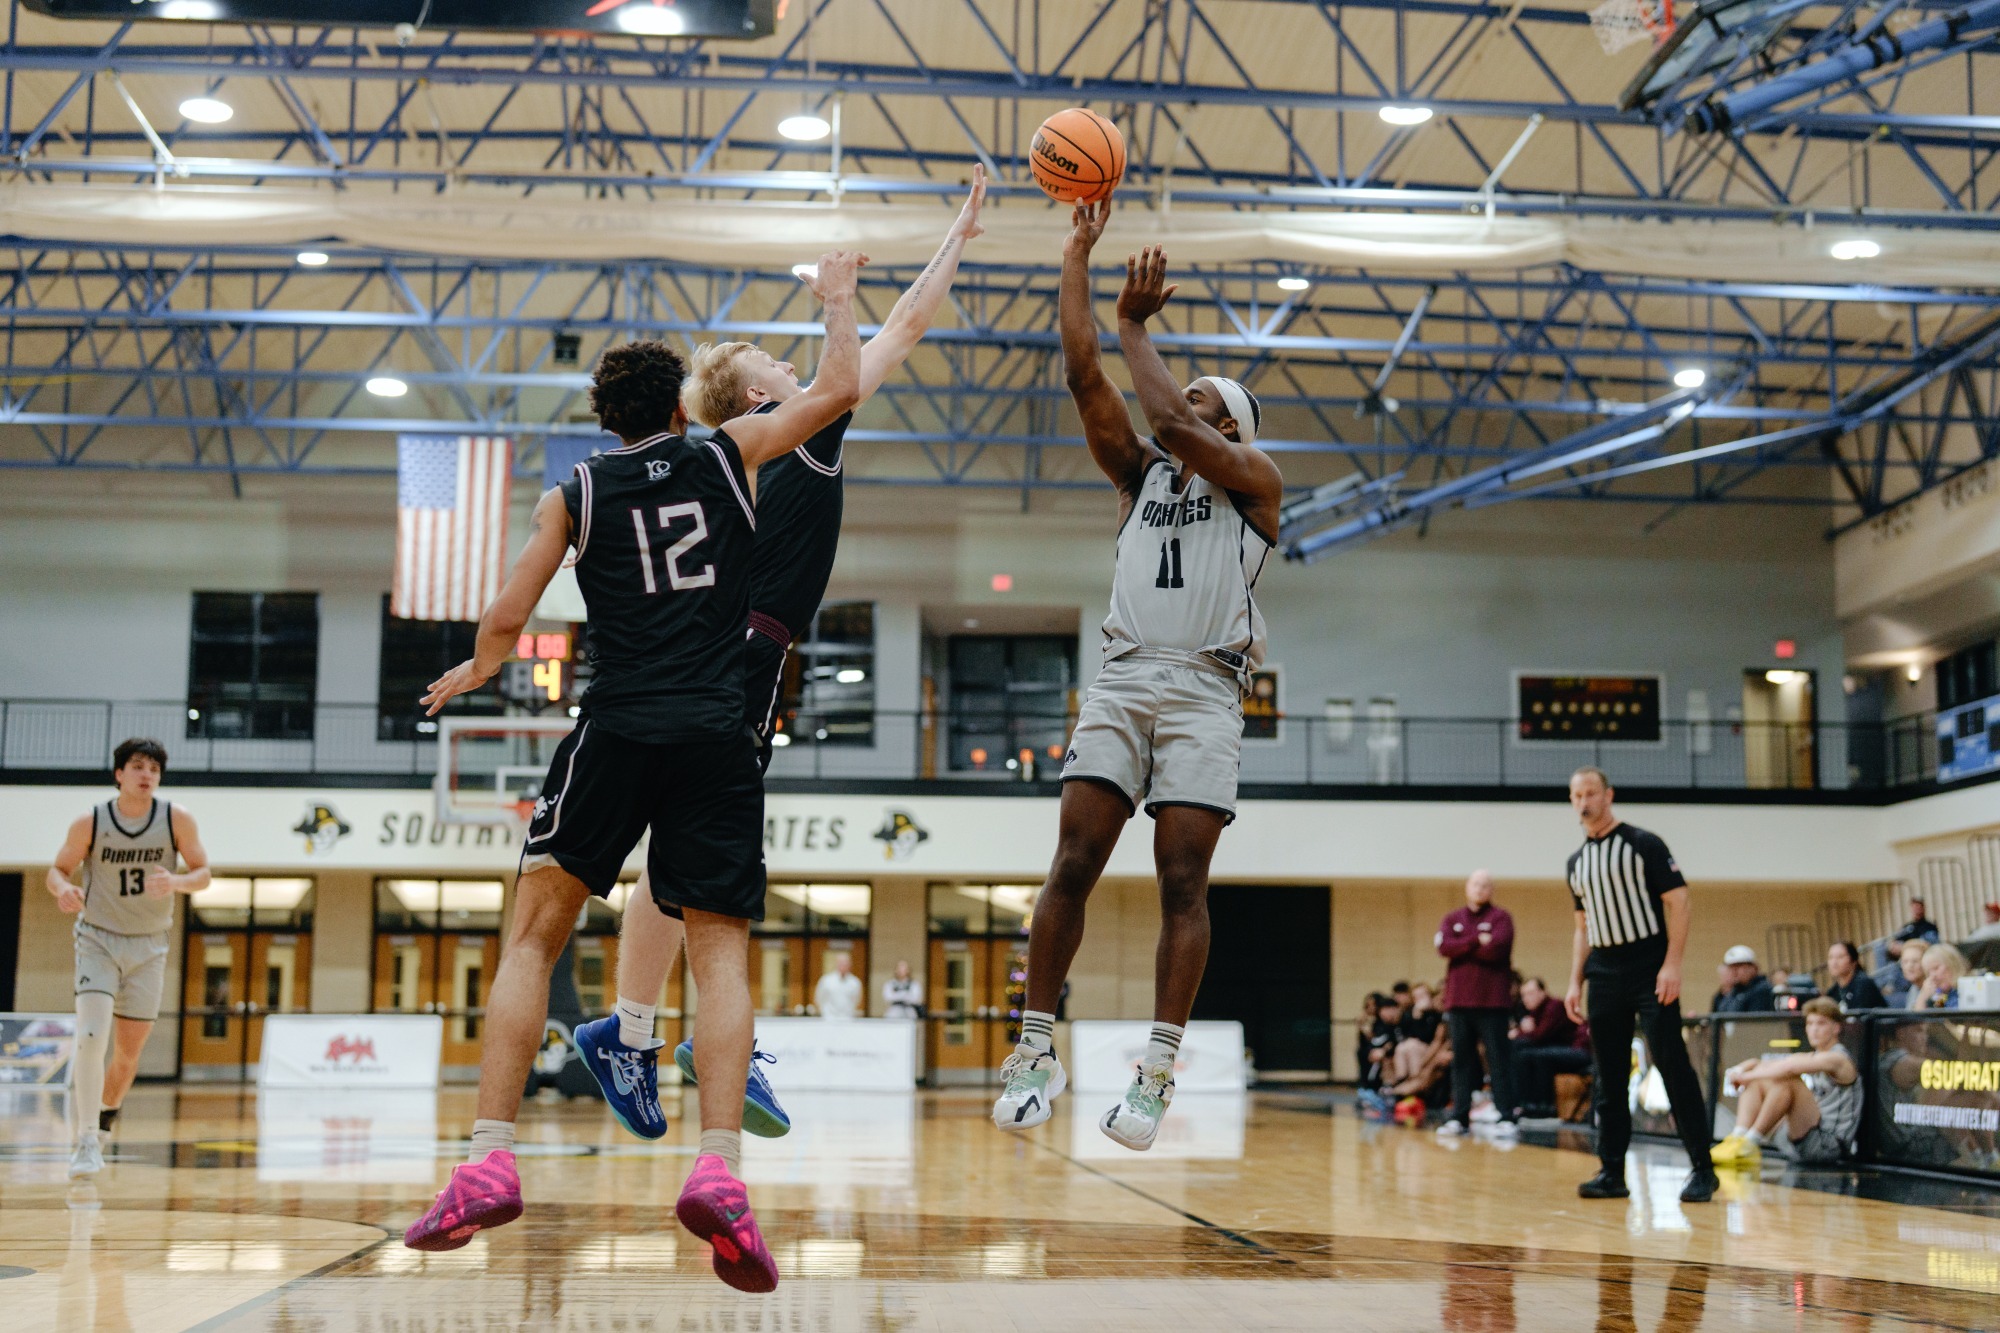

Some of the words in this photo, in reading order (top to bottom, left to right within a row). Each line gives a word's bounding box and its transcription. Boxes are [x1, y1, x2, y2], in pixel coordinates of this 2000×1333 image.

[631, 500, 716, 594] 12
[1155, 537, 1184, 589] 11
[533, 659, 562, 701] 4
[102, 846, 165, 864] PIRATES
[119, 868, 145, 897] 13
